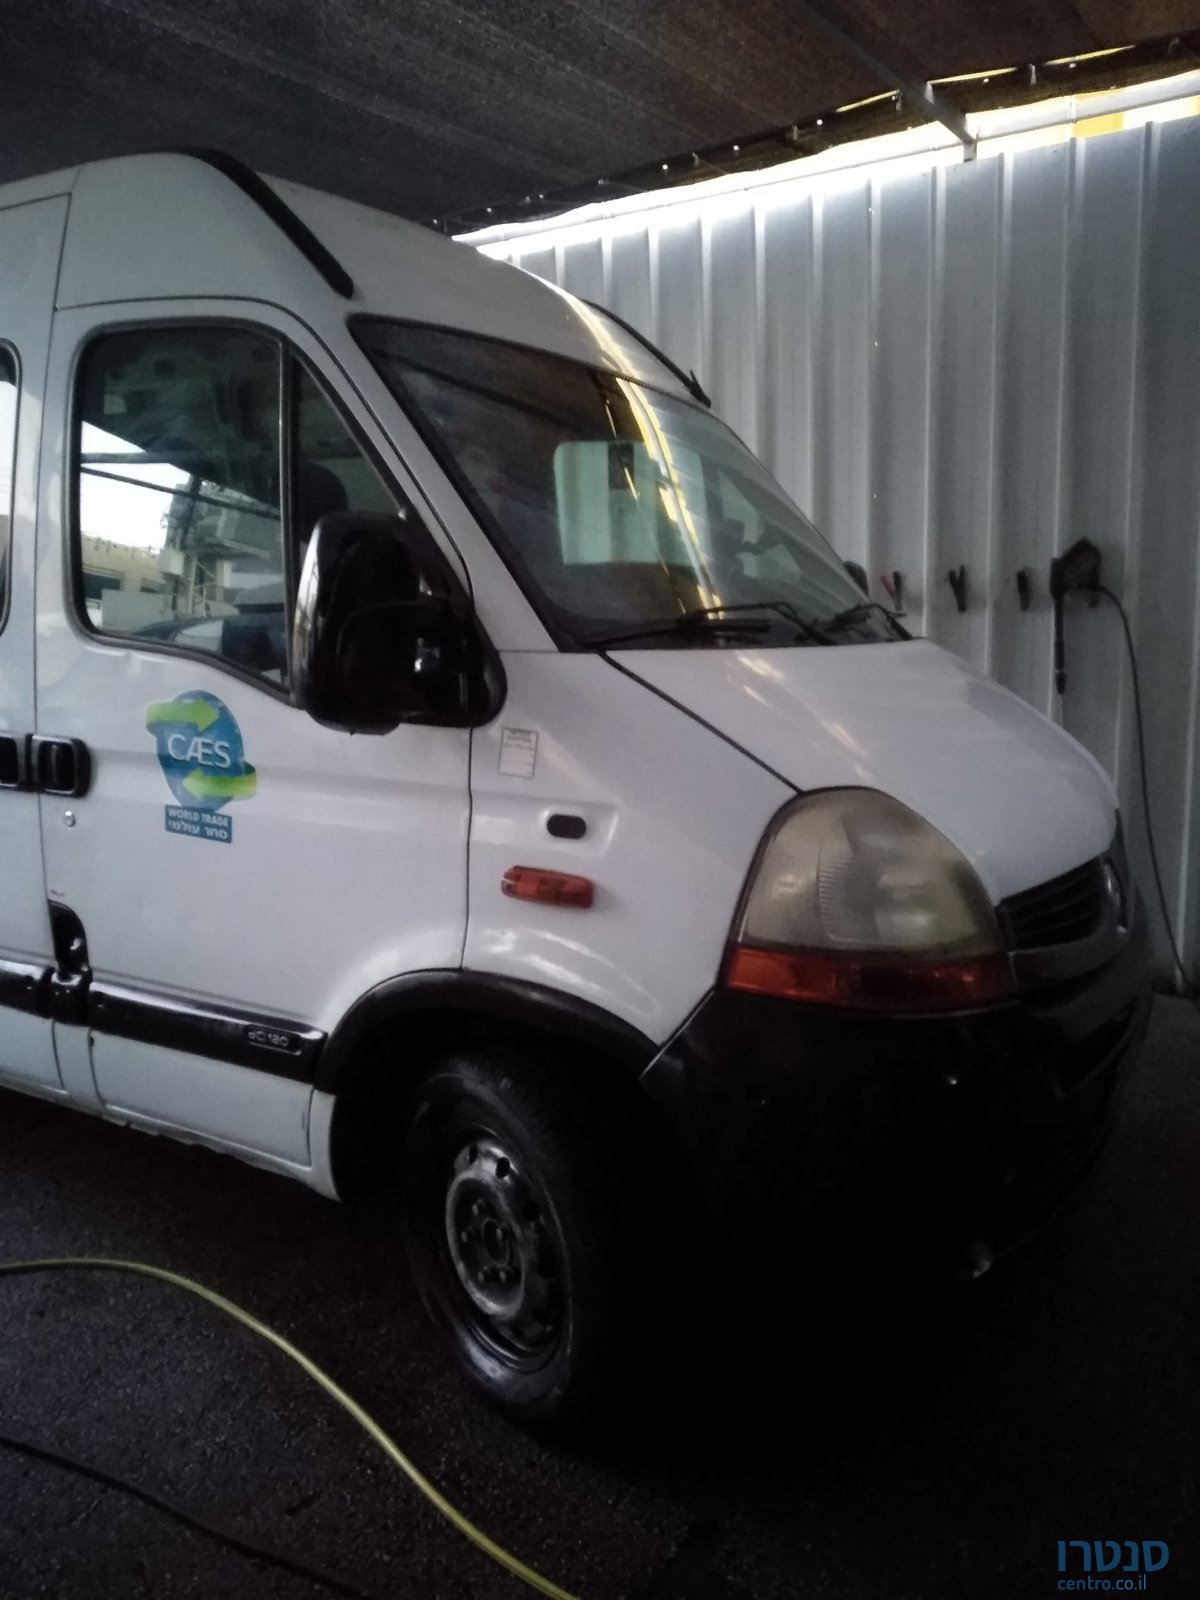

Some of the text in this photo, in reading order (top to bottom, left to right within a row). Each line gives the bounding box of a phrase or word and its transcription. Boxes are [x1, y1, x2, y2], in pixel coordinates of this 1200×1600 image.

[168, 807, 229, 828] WORLD TRADE
[168, 820, 228, 840] סחר עולמי
